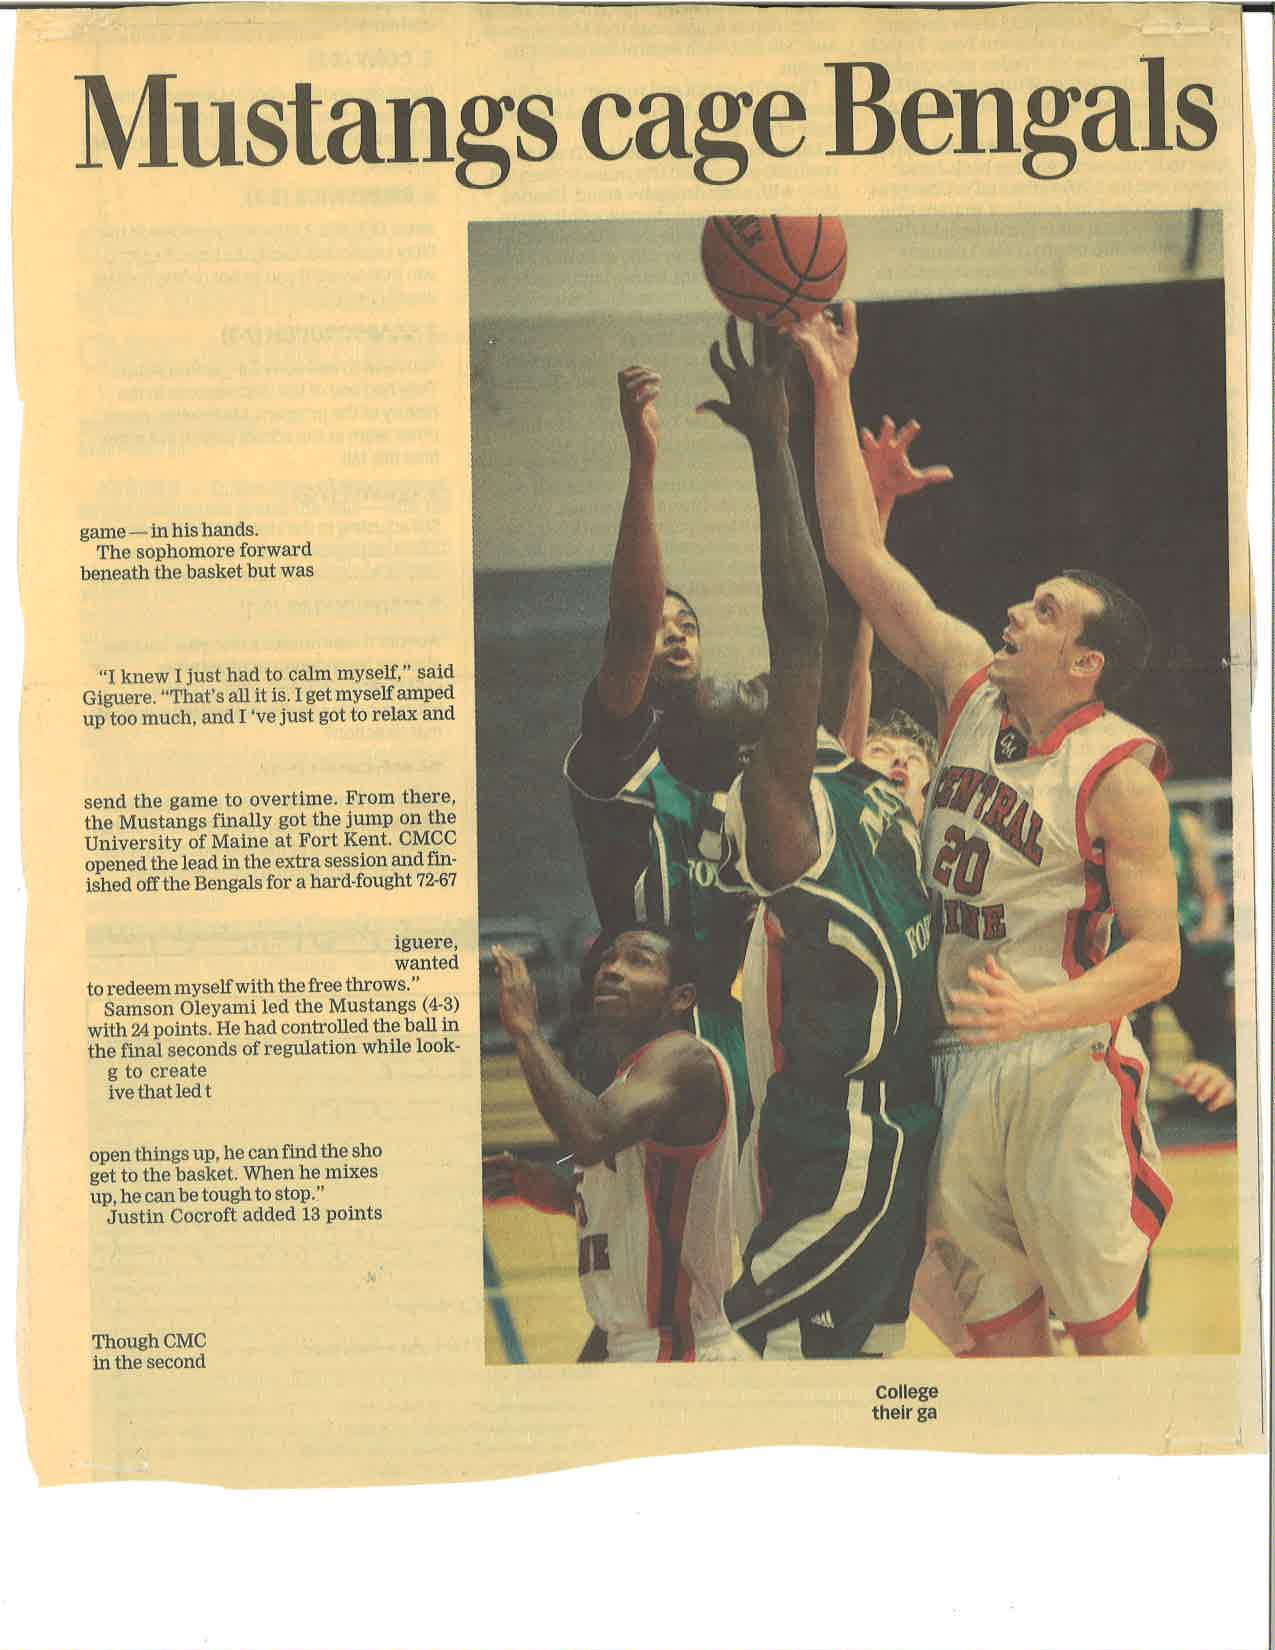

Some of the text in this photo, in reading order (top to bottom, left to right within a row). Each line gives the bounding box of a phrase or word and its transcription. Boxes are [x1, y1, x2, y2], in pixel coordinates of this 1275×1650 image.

[73, 73, 558, 189] Mustangs
[581, 91, 807, 186] cage
[823, 54, 1218, 184] Bengals
[79, 520, 259, 543] game in his hands.
[96, 544, 131, 560] The
[136, 543, 236, 563] sophomore
[239, 540, 313, 558] forward
[80, 562, 314, 582] beneath the basket but was
[121, 668, 170, 685] knew
[186, 667, 222, 687] just
[226, 665, 261, 683] had
[264, 667, 283, 682] to
[288, 665, 332, 682] calm
[417, 663, 455, 680] said
[82, 684, 455, 709] Giguere. all it is. get myself amped
[83, 704, 456, 730] up too much, and just got to relax and
[84, 788, 456, 812] send the game to overtime. From there,
[84, 808, 457, 832] the Mustangs finally got the jump on the
[84, 829, 457, 853] University of Maine at Fort Kent. CMCC
[84, 850, 457, 875] opened the lead in the extra session and fin-
[933, 824, 990, 896] 20
[86, 871, 457, 894] ished off the Bengals for hard-fought 72-67
[394, 934, 458, 953] iguere,
[394, 953, 459, 971] wanted
[87, 982, 104, 997] to
[107, 980, 172, 997] redeem
[174, 978, 234, 998] myself
[235, 978, 274, 994] with
[277, 977, 306, 994] the
[308, 977, 343, 993] free
[104, 996, 460, 1018] Samson Oleyami led the Mustangs (4-3)
[87, 1016, 460, 1041] with 24 points. He had controlled the ball in
[87, 1036, 461, 1059] the final seconds of regulation while look-
[125, 1063, 207, 1080] to create
[137, 1082, 202, 1100] that led
[89, 1143, 349, 1166] open things up, he can find the
[89, 1163, 378, 1186] get to the basket. When he mixes
[89, 1192, 117, 1208] up,
[120, 1188, 142, 1204] he
[144, 1191, 176, 1204] can
[178, 1186, 199, 1203] be
[201, 1185, 252, 1205] tough
[254, 1186, 272, 1202] to
[106, 1205, 383, 1225] Justin Cocroft added 13 points
[91, 1332, 207, 1352] Though CMC
[92, 1352, 207, 1371] in the second
[875, 1383, 939, 1402] College
[871, 1404, 937, 1423] their ga
